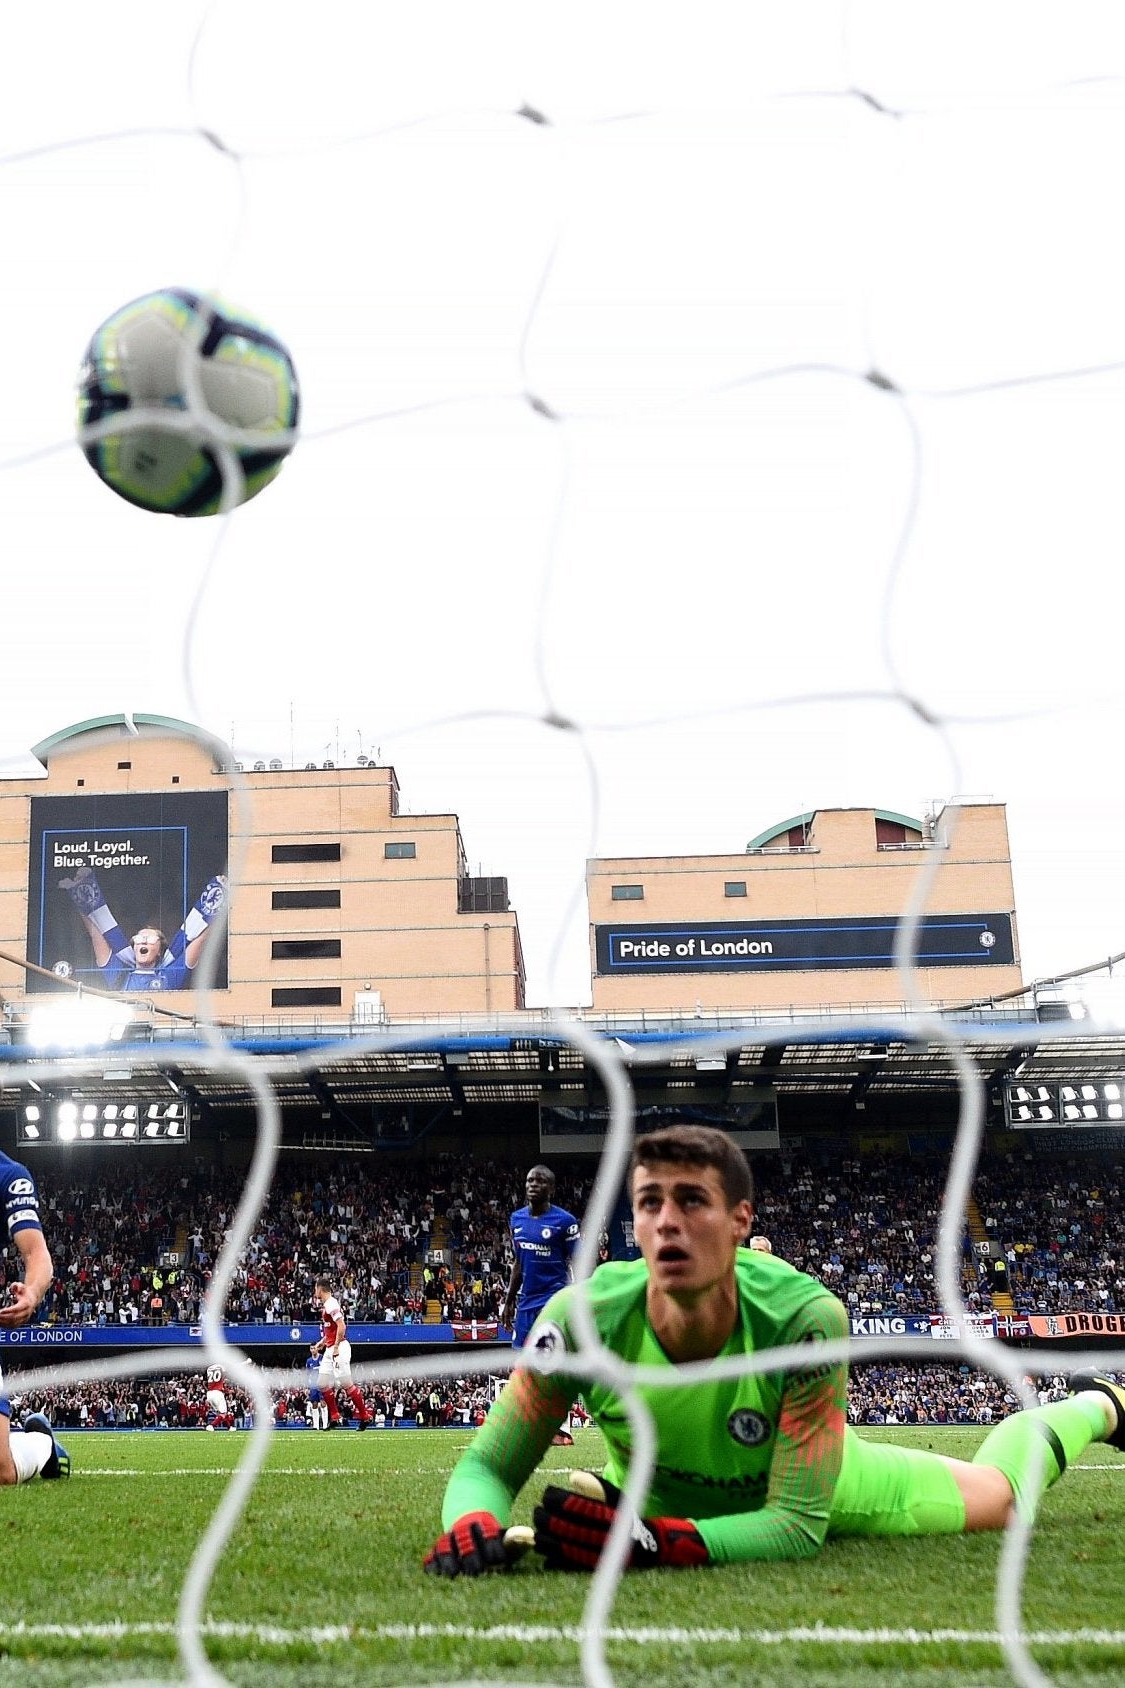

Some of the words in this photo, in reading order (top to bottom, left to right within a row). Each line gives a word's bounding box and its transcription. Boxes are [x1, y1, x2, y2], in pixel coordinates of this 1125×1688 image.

[54, 841, 91, 853] Loud.
[94, 840, 134, 854] Loyal.
[54, 855, 87, 867] Blue.
[88, 854, 150, 868] Together.
[620, 941, 671, 957] Pride
[675, 940, 695, 956] of
[700, 939, 772, 956] London
[981, 1243, 989, 1251] 6
[171, 1254, 177, 1263] 3
[435, 1251, 441, 1259] 4
[852, 1317, 906, 1335] KING
[10, 1331, 27, 1342] OF
[30, 1330, 83, 1342] LONDON
[207, 1370, 221, 1382] 20
